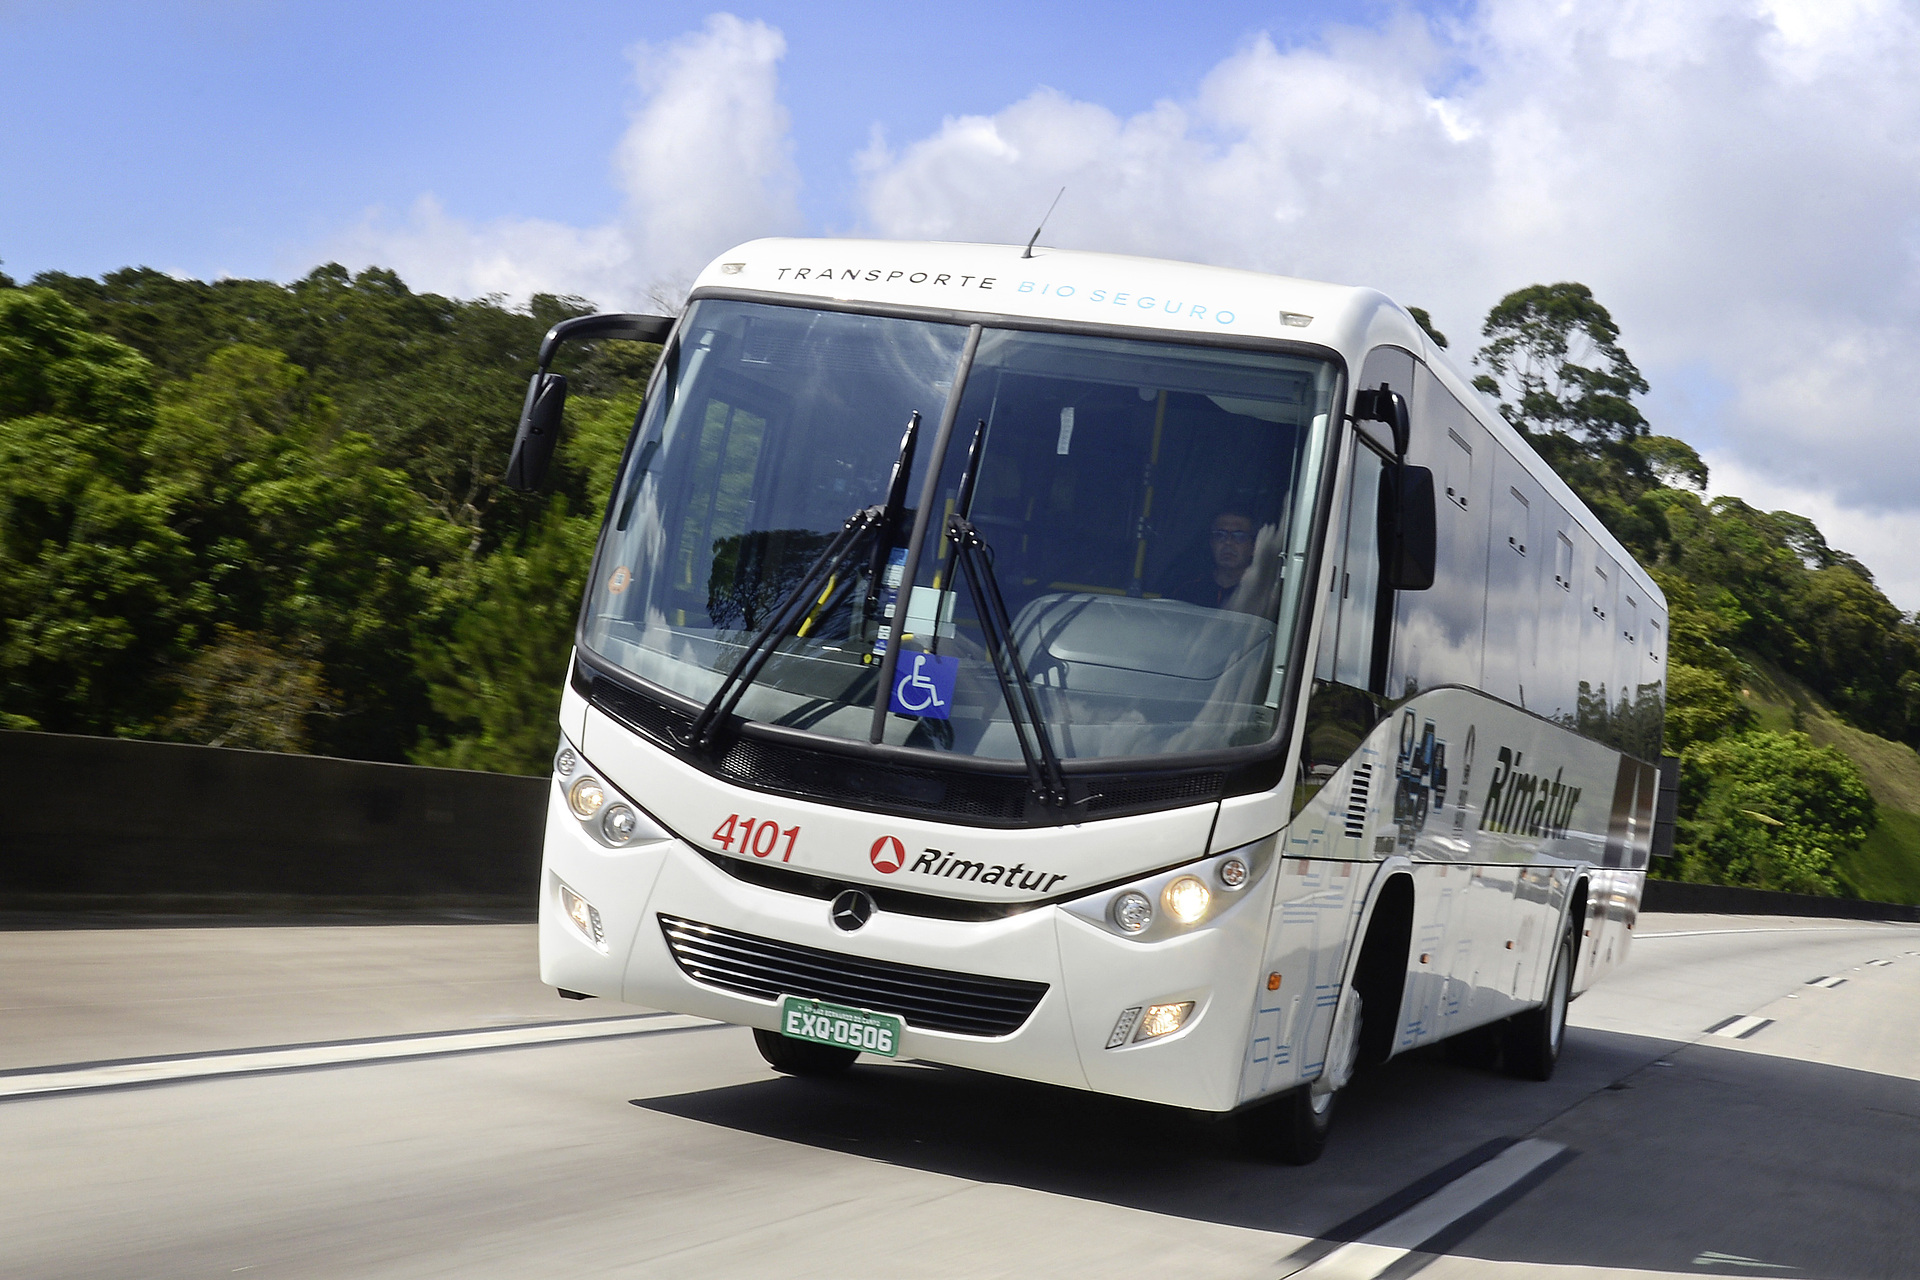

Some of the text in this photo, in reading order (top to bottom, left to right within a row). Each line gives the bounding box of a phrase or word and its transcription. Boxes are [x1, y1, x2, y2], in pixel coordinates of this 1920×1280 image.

[777, 267, 1236, 325] TRANSPORTE BIO SEGURO
[1478, 745, 1583, 840] Rimatur
[711, 813, 802, 863] 4101
[910, 847, 1068, 894] Rimatur
